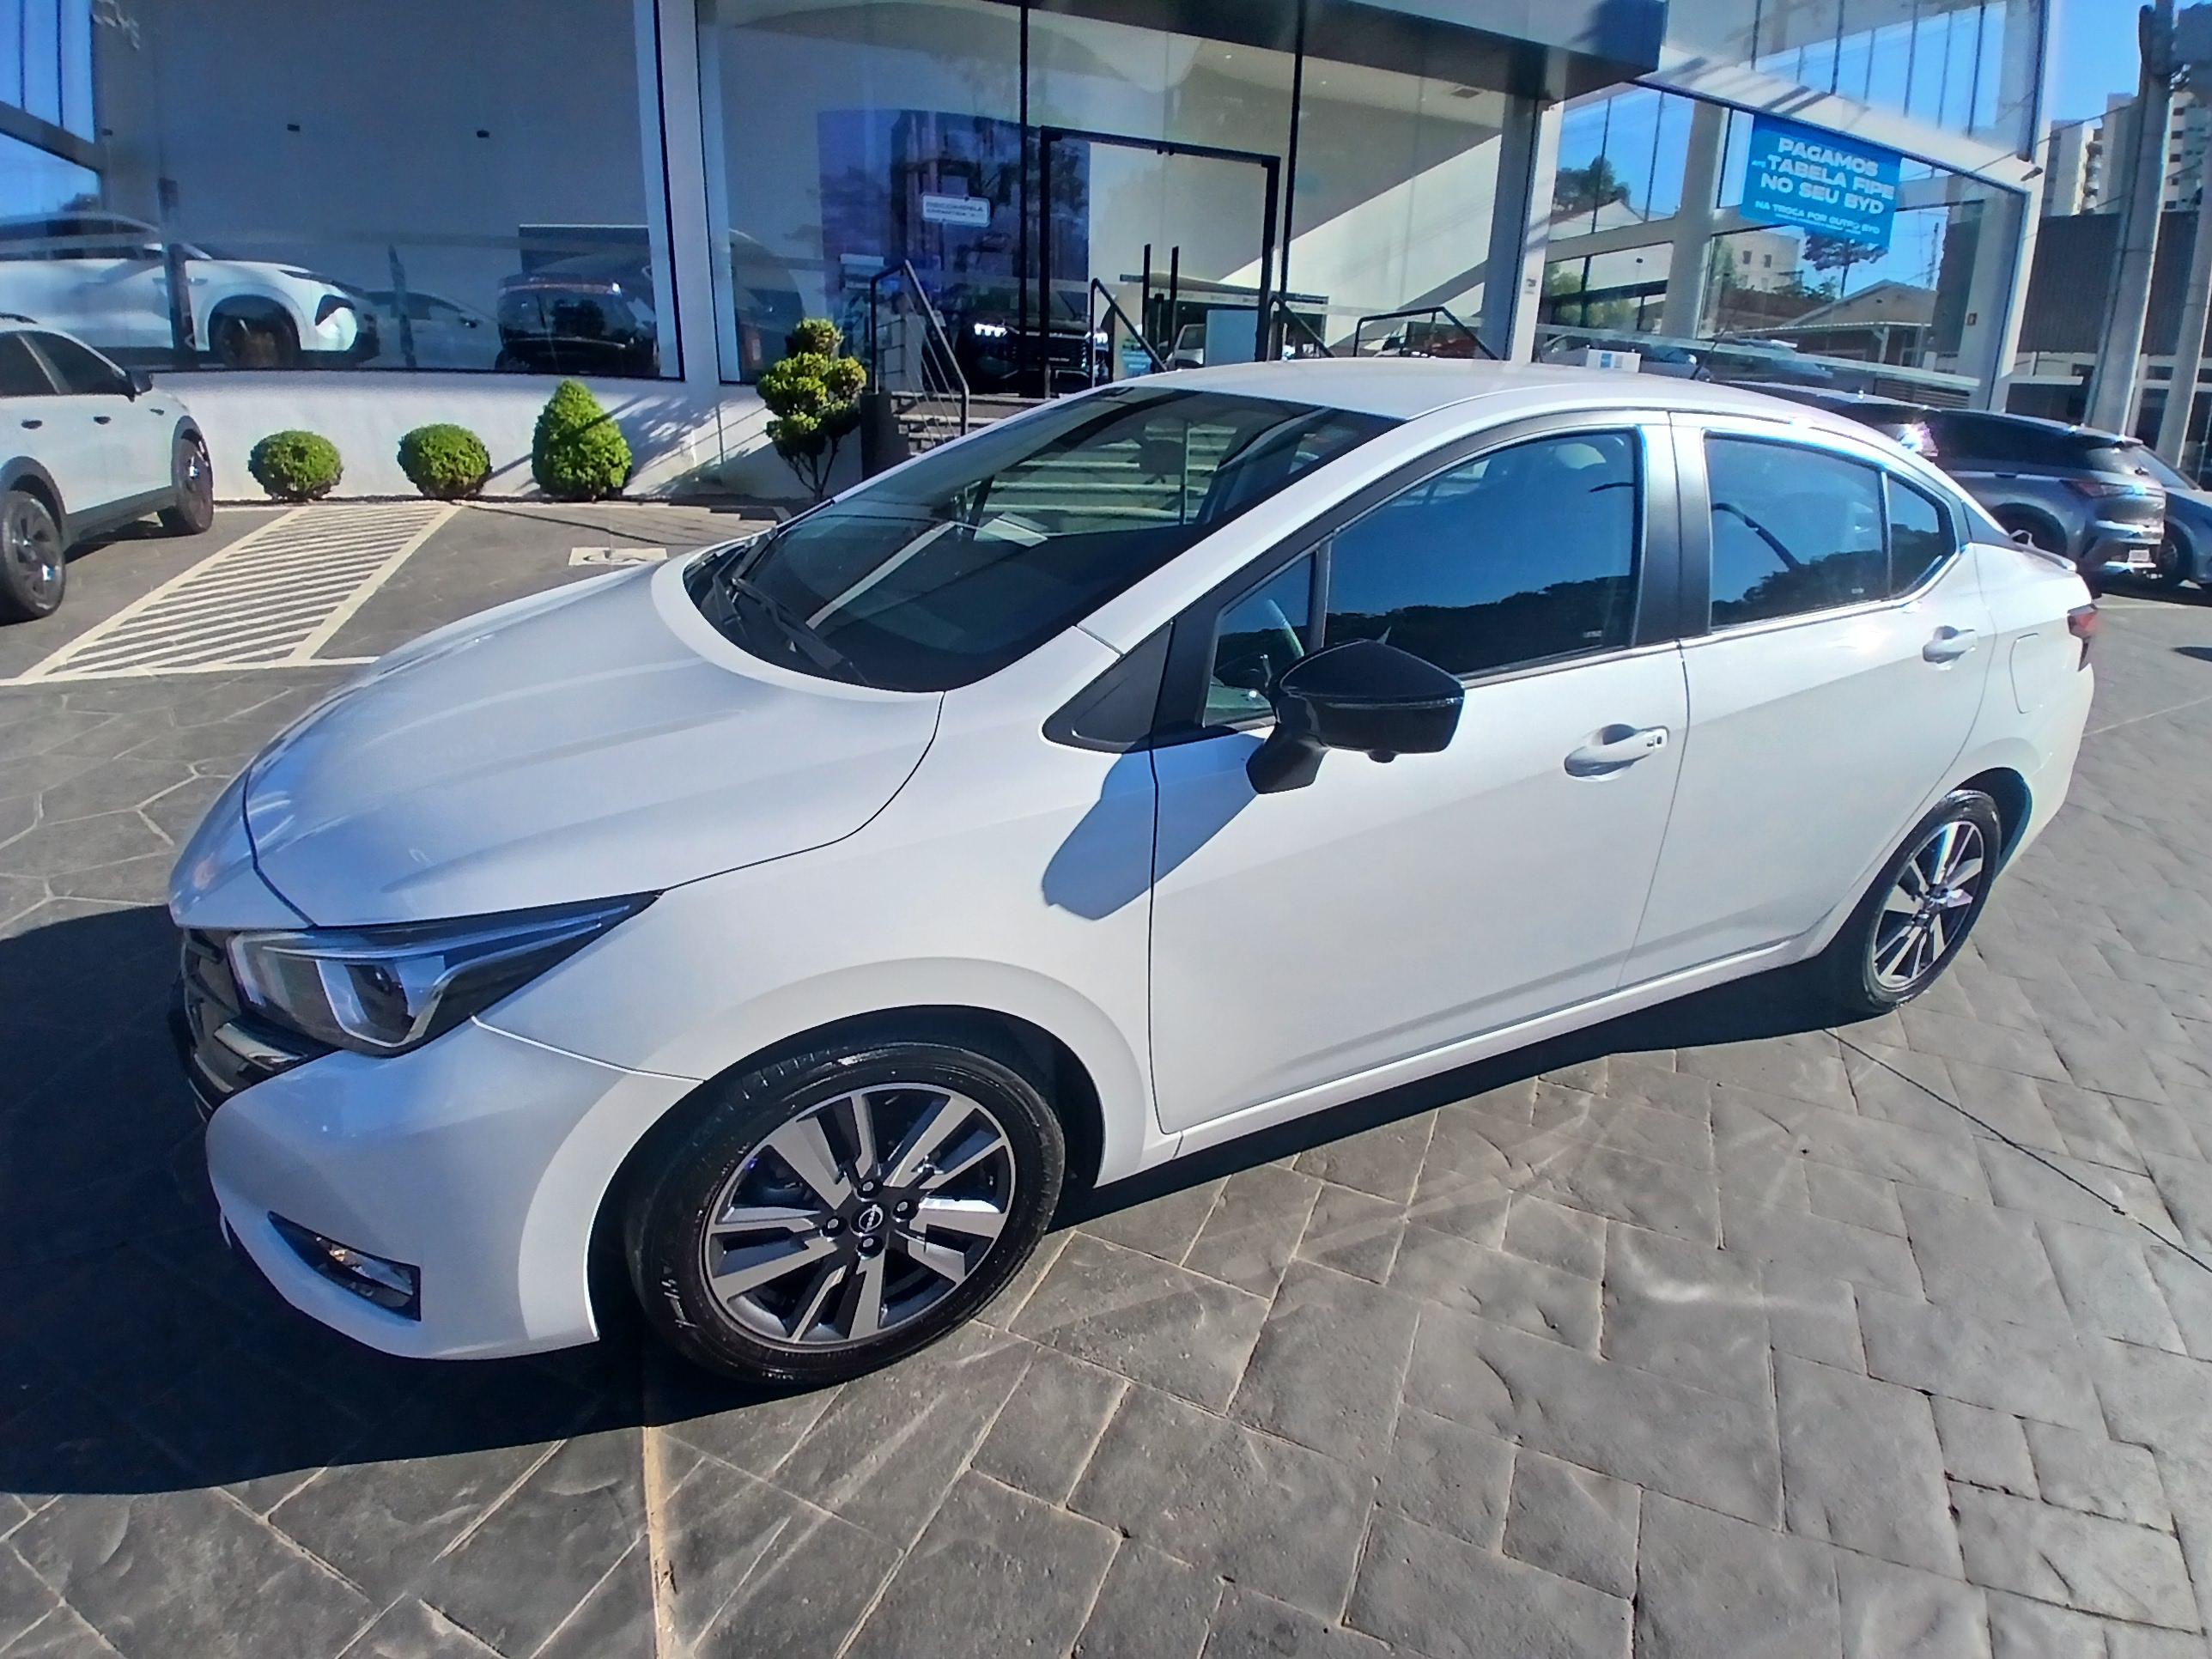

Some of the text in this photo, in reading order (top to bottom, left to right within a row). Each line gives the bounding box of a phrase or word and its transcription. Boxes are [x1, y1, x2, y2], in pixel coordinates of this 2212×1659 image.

[1778, 137, 1879, 177] PAGAMOS
[1760, 173, 1884, 214] NO SEU BYD
[1767, 155, 1846, 188] TABELA
[1852, 175, 1895, 200] FIPE
[1755, 200, 1771, 210] NA
[1772, 204, 1805, 217] TROCA
[1808, 211, 1827, 222] POR
[1829, 216, 1860, 229] OUTRO
